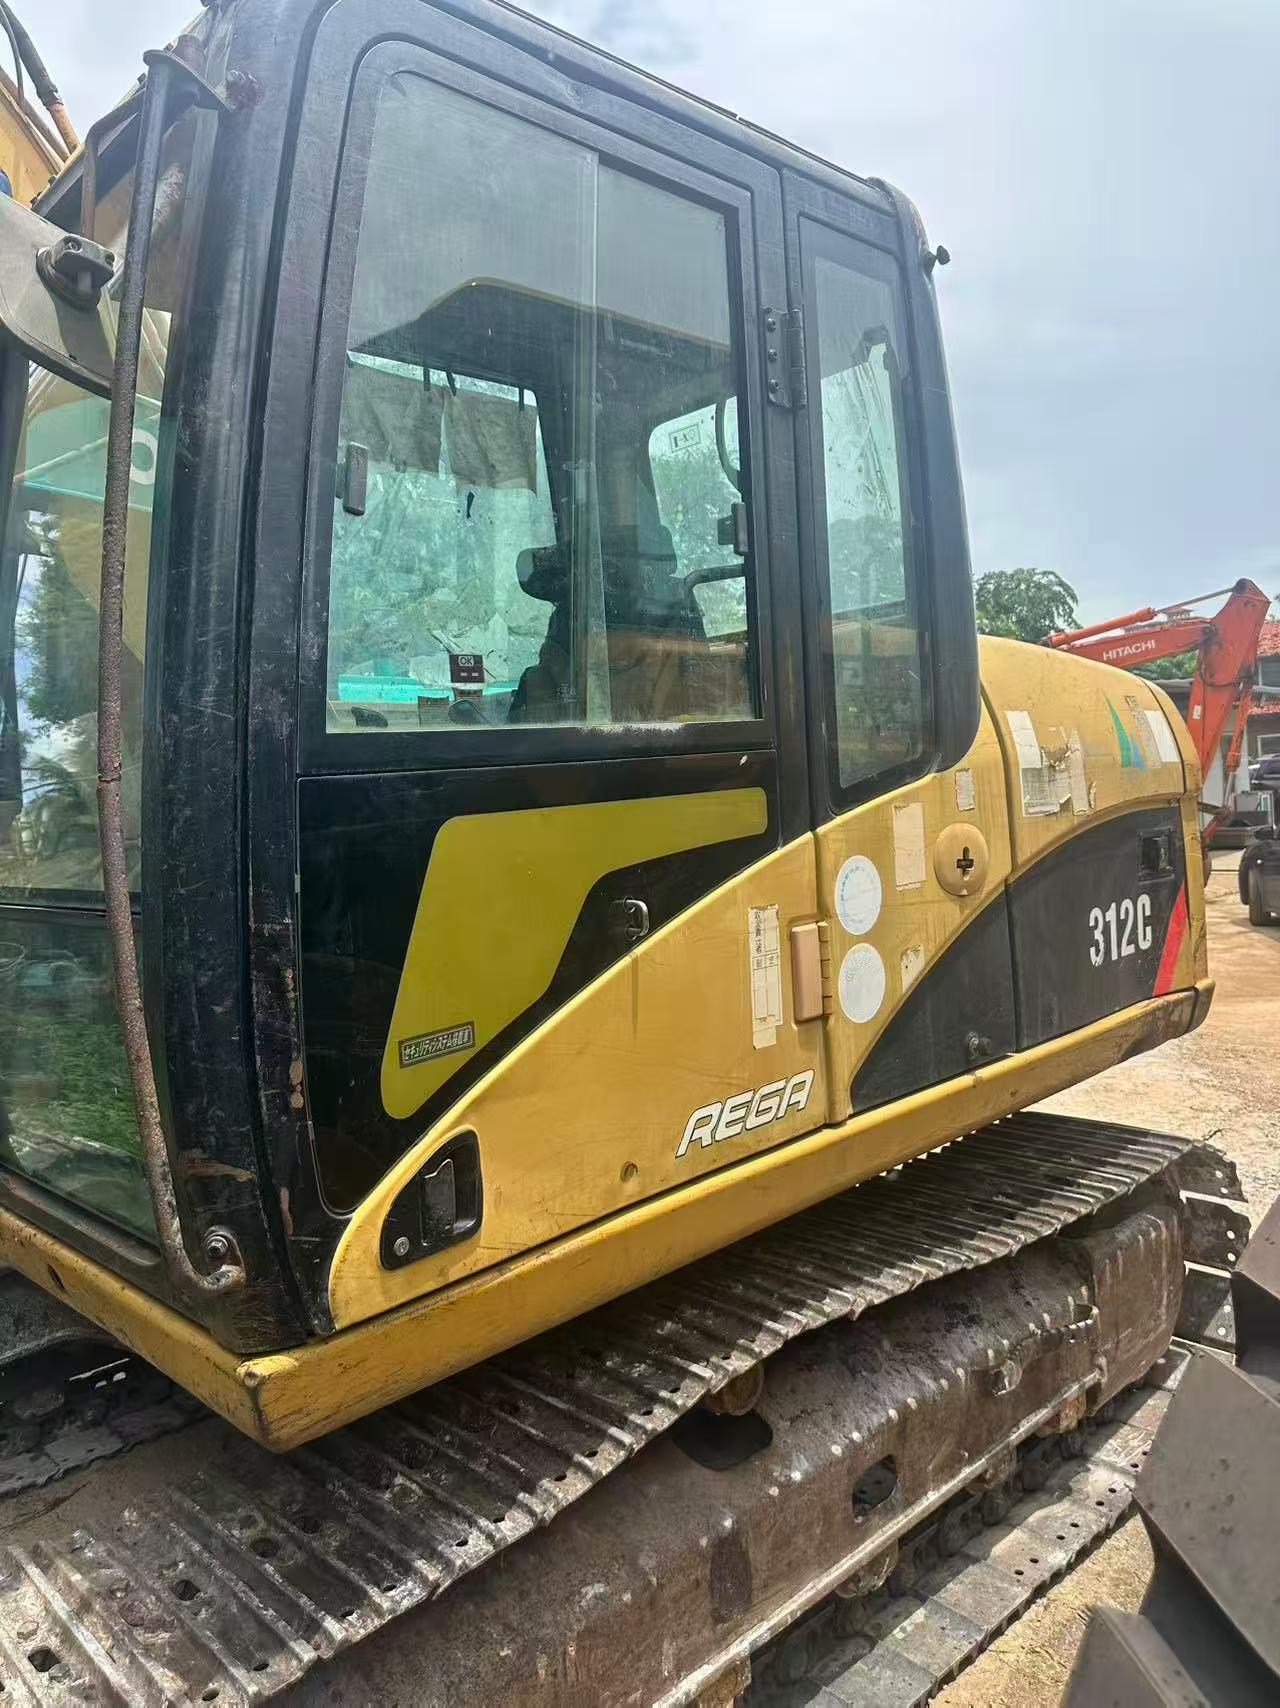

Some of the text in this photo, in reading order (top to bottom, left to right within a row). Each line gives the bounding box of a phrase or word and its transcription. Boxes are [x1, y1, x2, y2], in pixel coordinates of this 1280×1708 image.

[460, 656, 473, 665] OK
[1103, 639, 1156, 661] HITACHI
[1089, 893, 1152, 966] 312C
[675, 1069, 815, 1158] REGA
